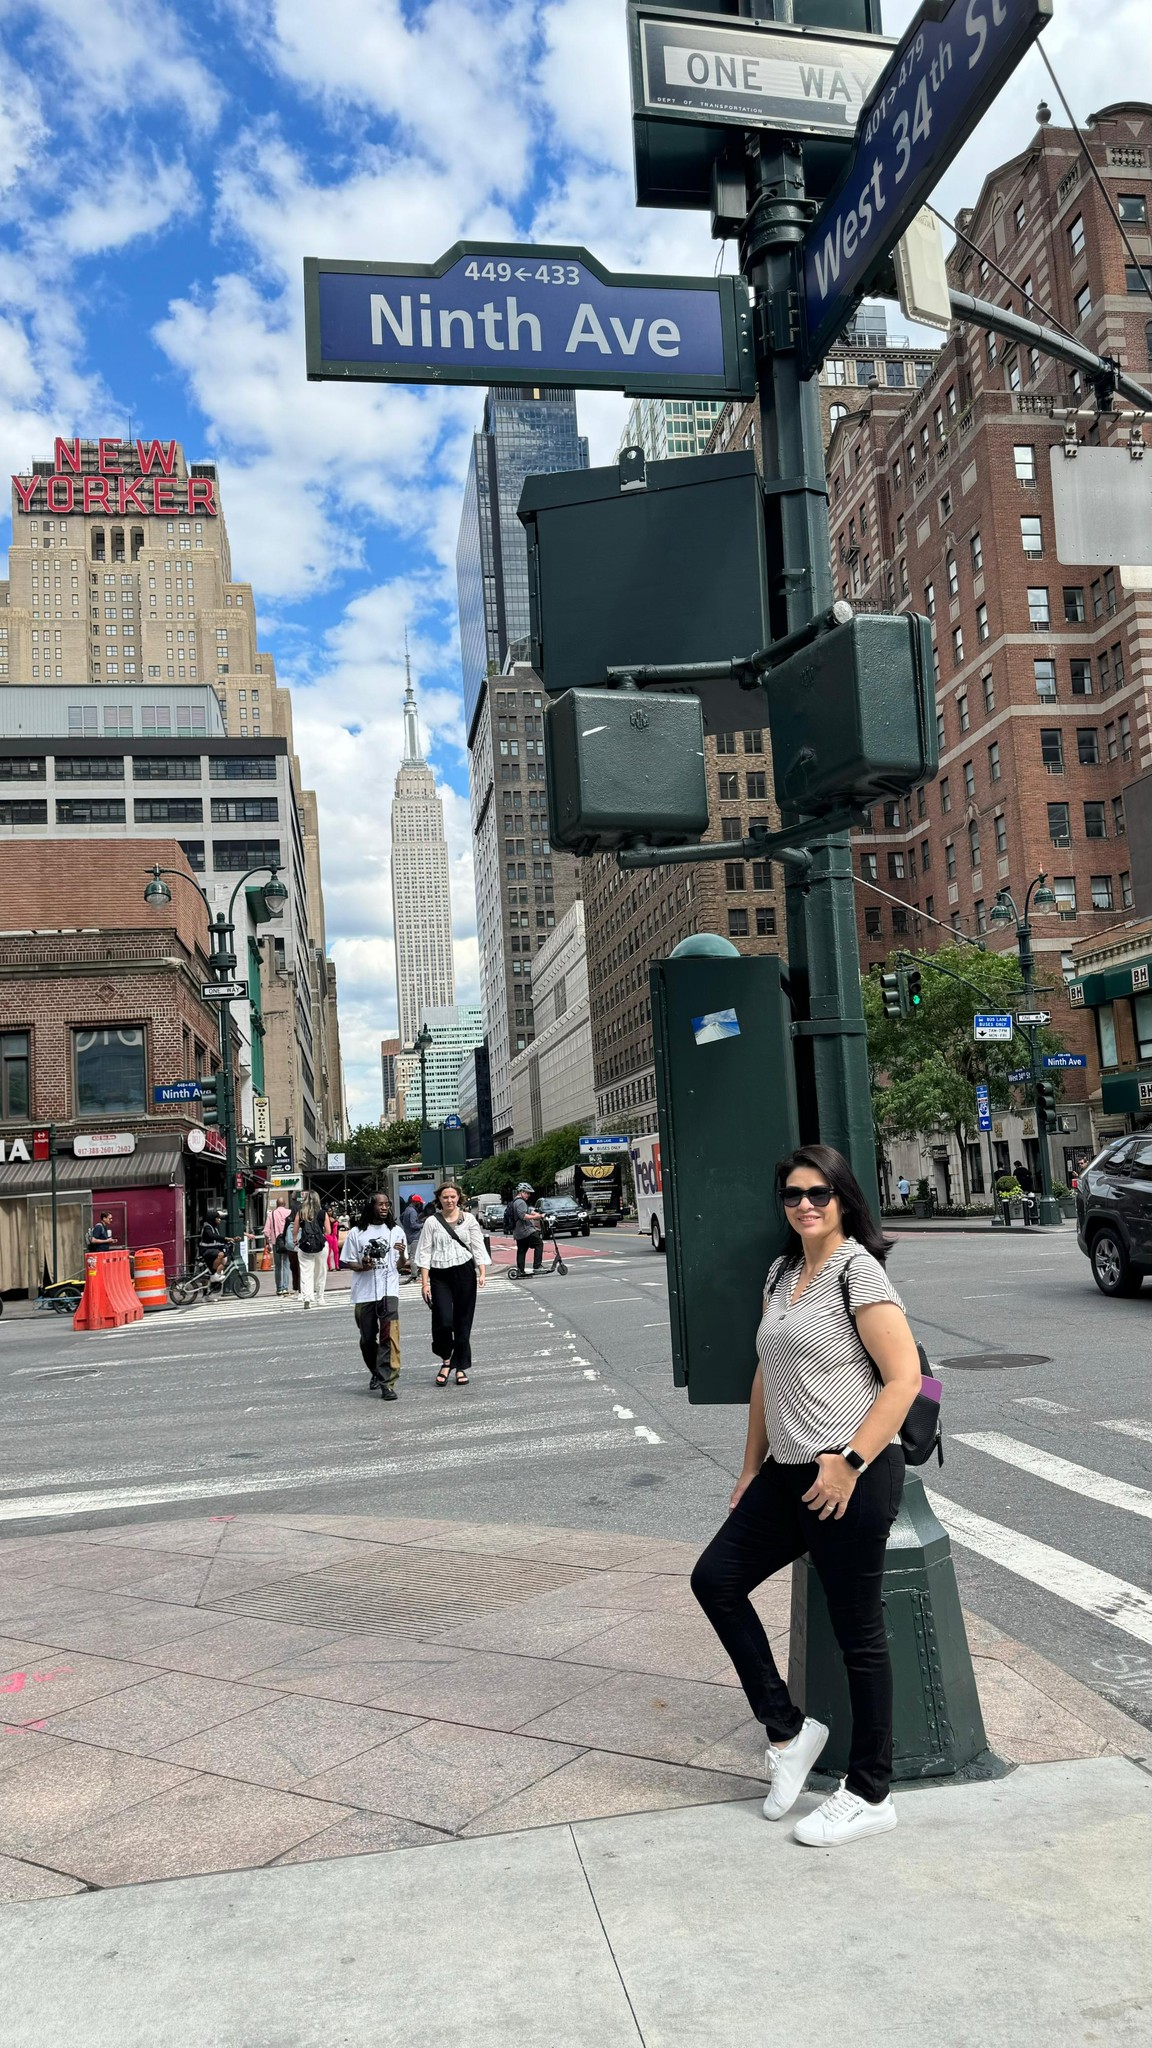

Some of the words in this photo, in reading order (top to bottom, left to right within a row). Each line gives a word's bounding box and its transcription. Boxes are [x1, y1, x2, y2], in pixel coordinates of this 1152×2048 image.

[686, 52, 763, 91] ONE
[798, 65, 875, 102] WAY
[864, 95, 888, 146] 401
[897, 33, 925, 84] 479
[700, 102, 763, 113] TRANSPORTATION
[813, 156, 886, 300] West
[891, 40, 953, 184] 34th
[464, 261, 512, 282] 449
[534, 264, 580, 285] 433
[369, 293, 542, 352] Ninth
[564, 303, 682, 357] Ave
[54, 437, 176, 475] NEW
[11, 475, 218, 515] YORKER
[1133, 968, 1147, 982] BH
[1070, 986, 1083, 999] BH
[1047, 1057, 1067, 1066] Ninth
[1068, 1058, 1082, 1066] Ave
[162, 1088, 190, 1099] Ninth
[1008, 1074, 1018, 1082] West
[630, 1143, 663, 1195] FedE
